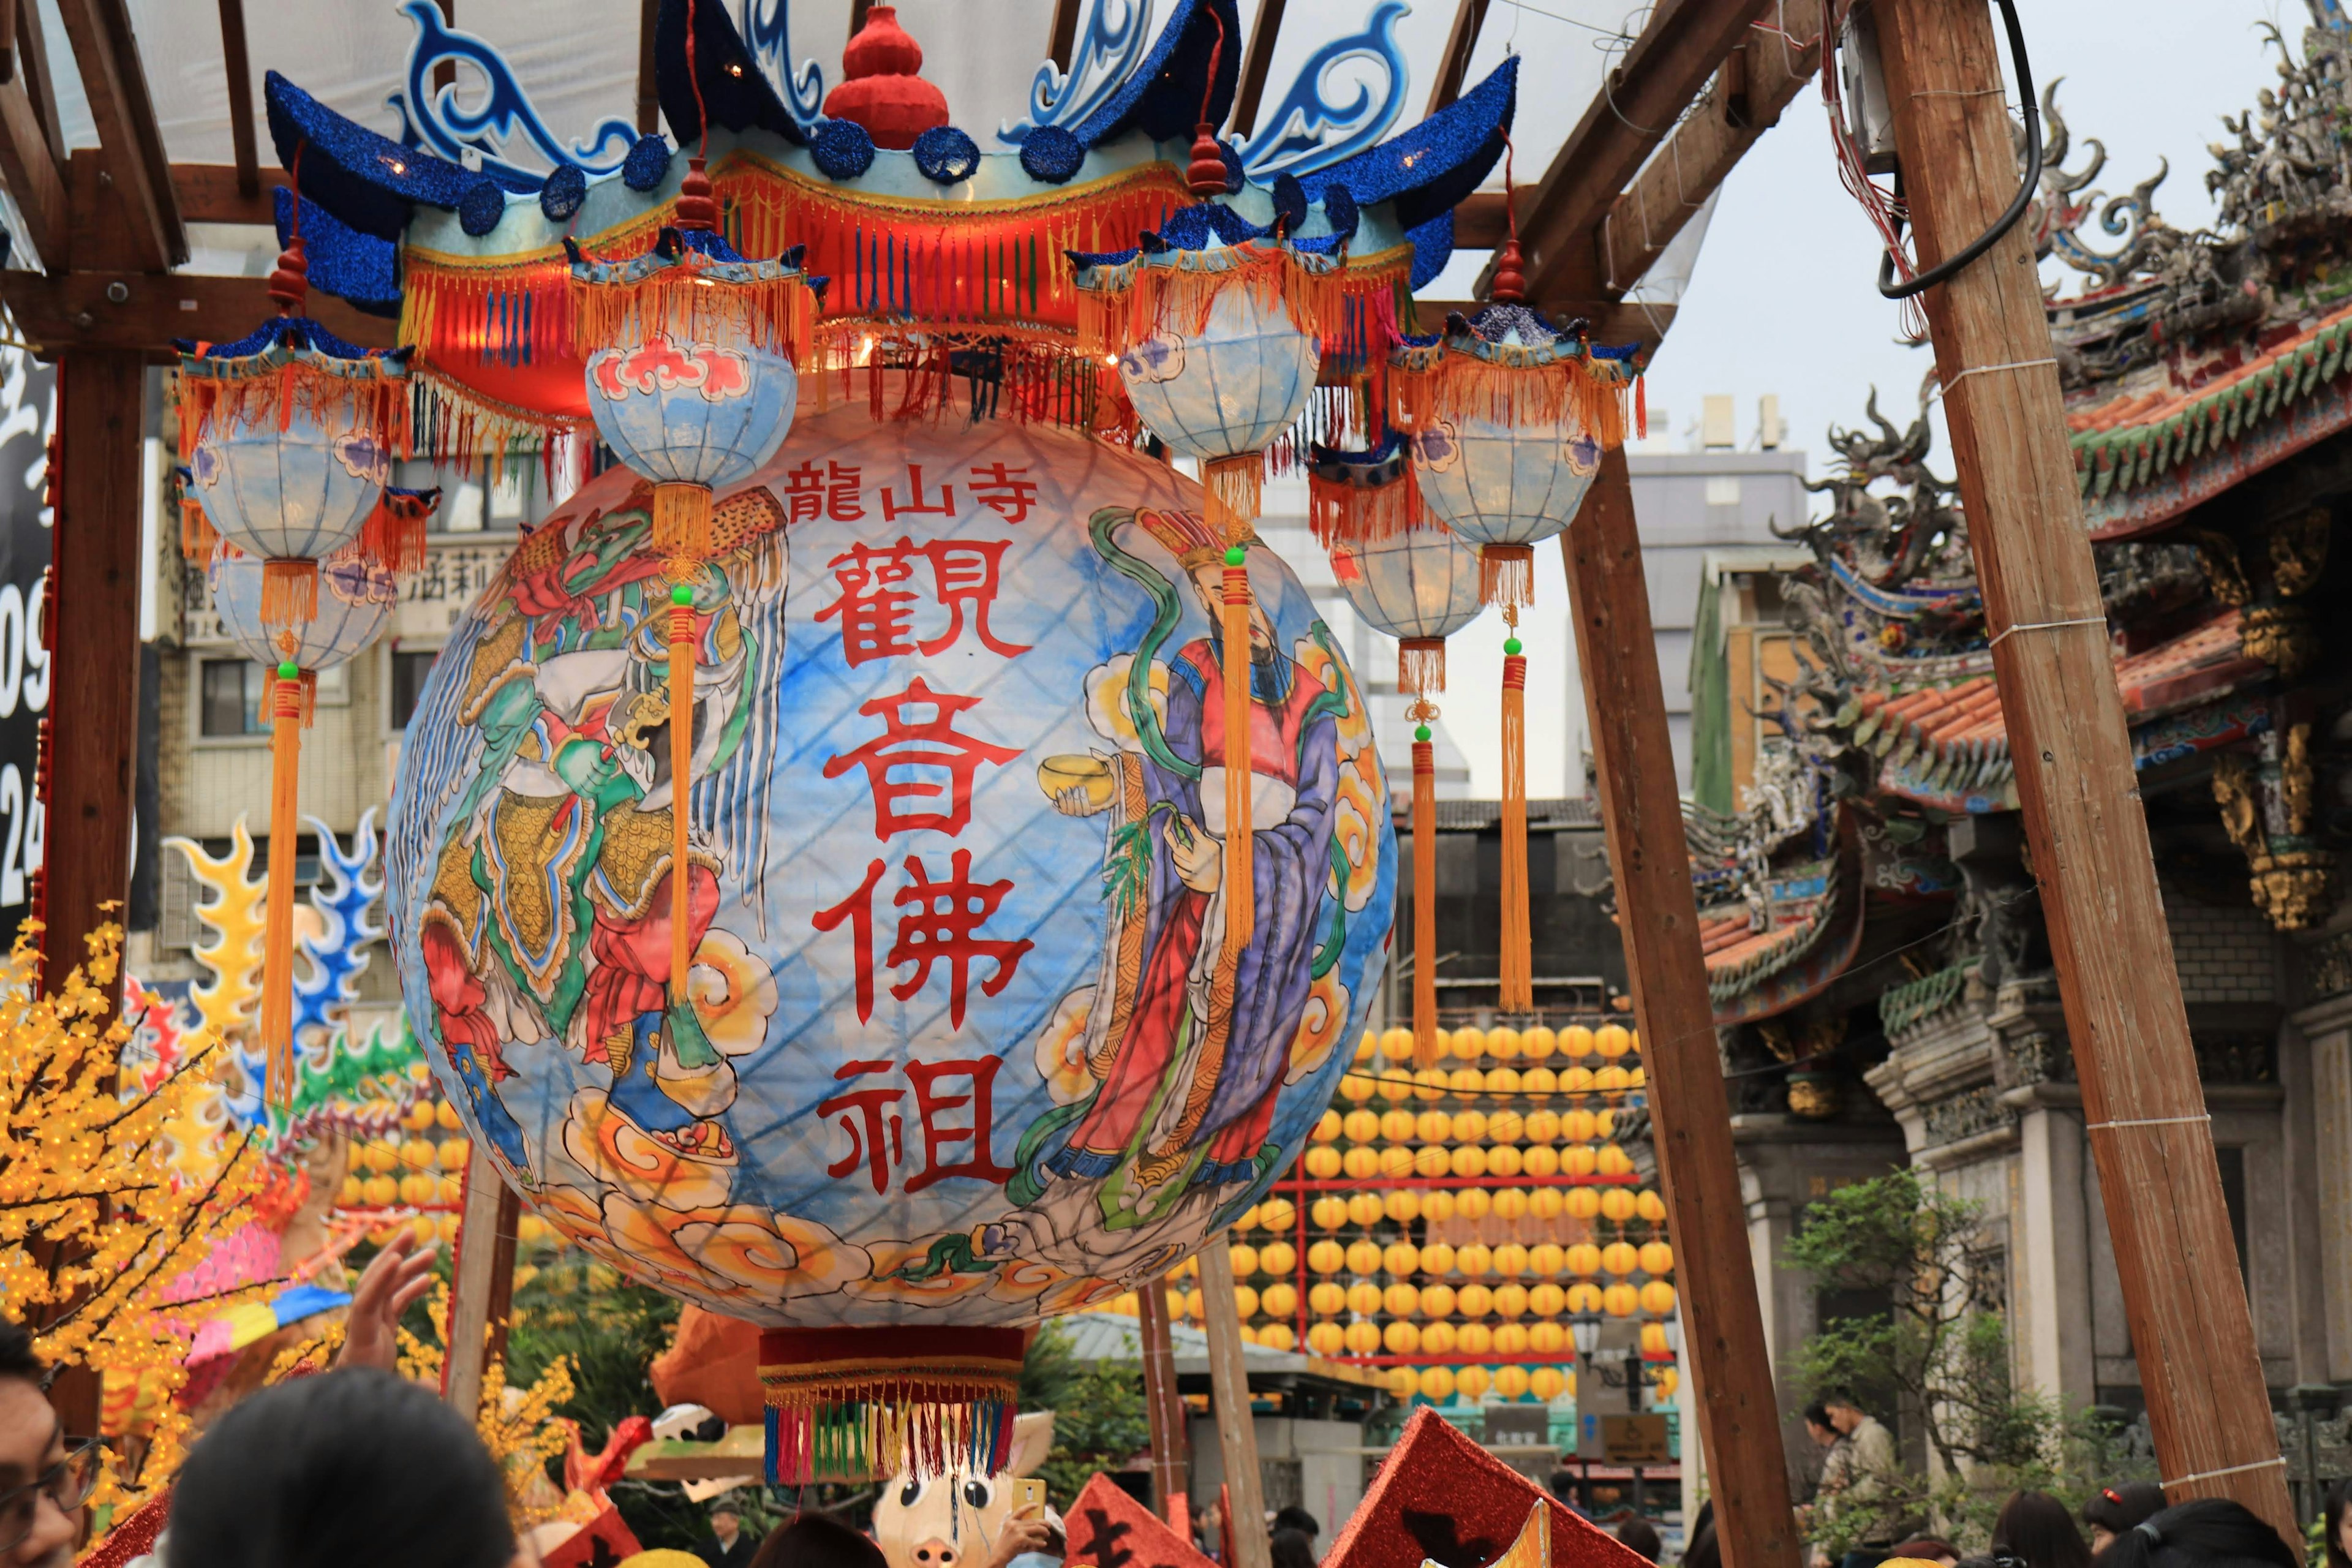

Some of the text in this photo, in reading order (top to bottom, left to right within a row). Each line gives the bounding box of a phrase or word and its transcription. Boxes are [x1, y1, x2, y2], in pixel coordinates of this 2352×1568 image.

[784, 461, 1038, 525] 龍山寺
[812, 535, 1035, 1196] 觀音佛祖
